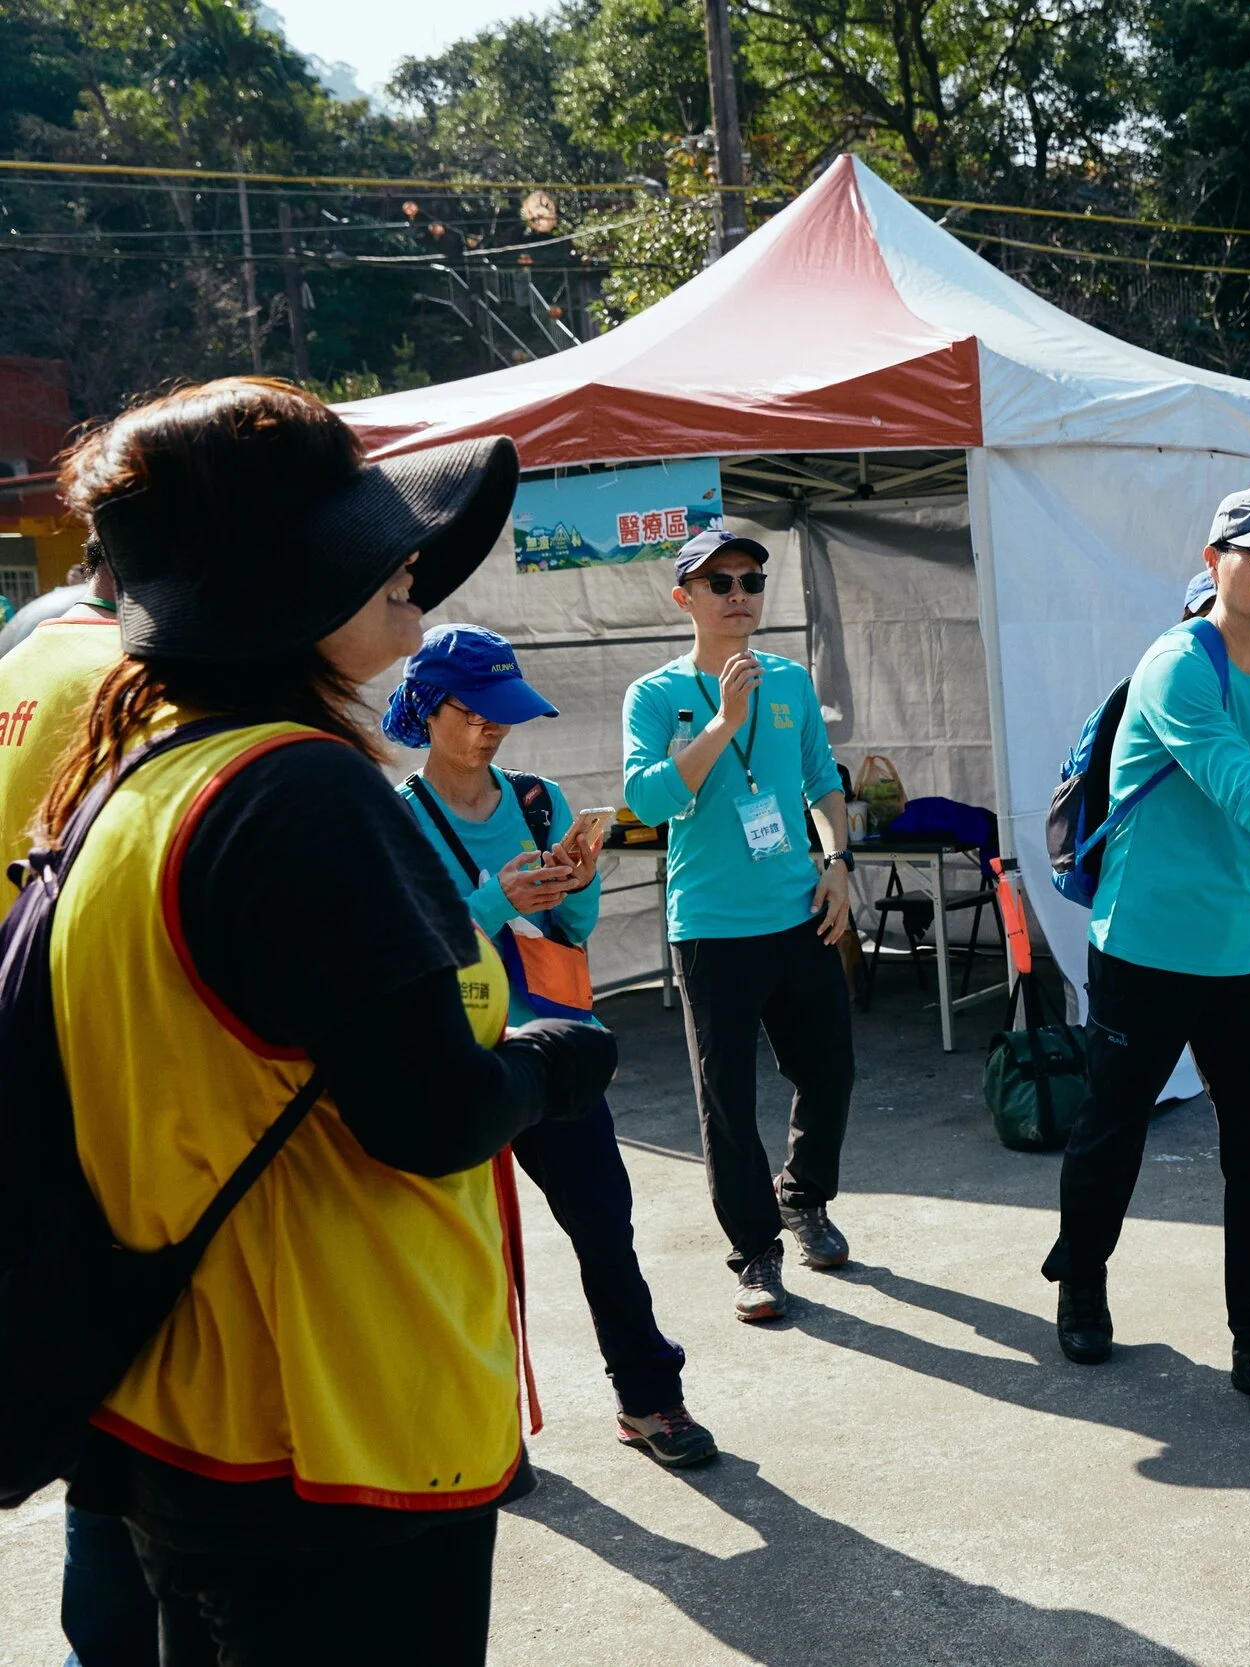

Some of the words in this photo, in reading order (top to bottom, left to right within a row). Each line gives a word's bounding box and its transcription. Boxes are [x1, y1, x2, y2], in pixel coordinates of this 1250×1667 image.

[618, 508, 687, 545] 醫療區
[491, 662, 515, 672] ATUNAS
[750, 822, 780, 841] 工作證
